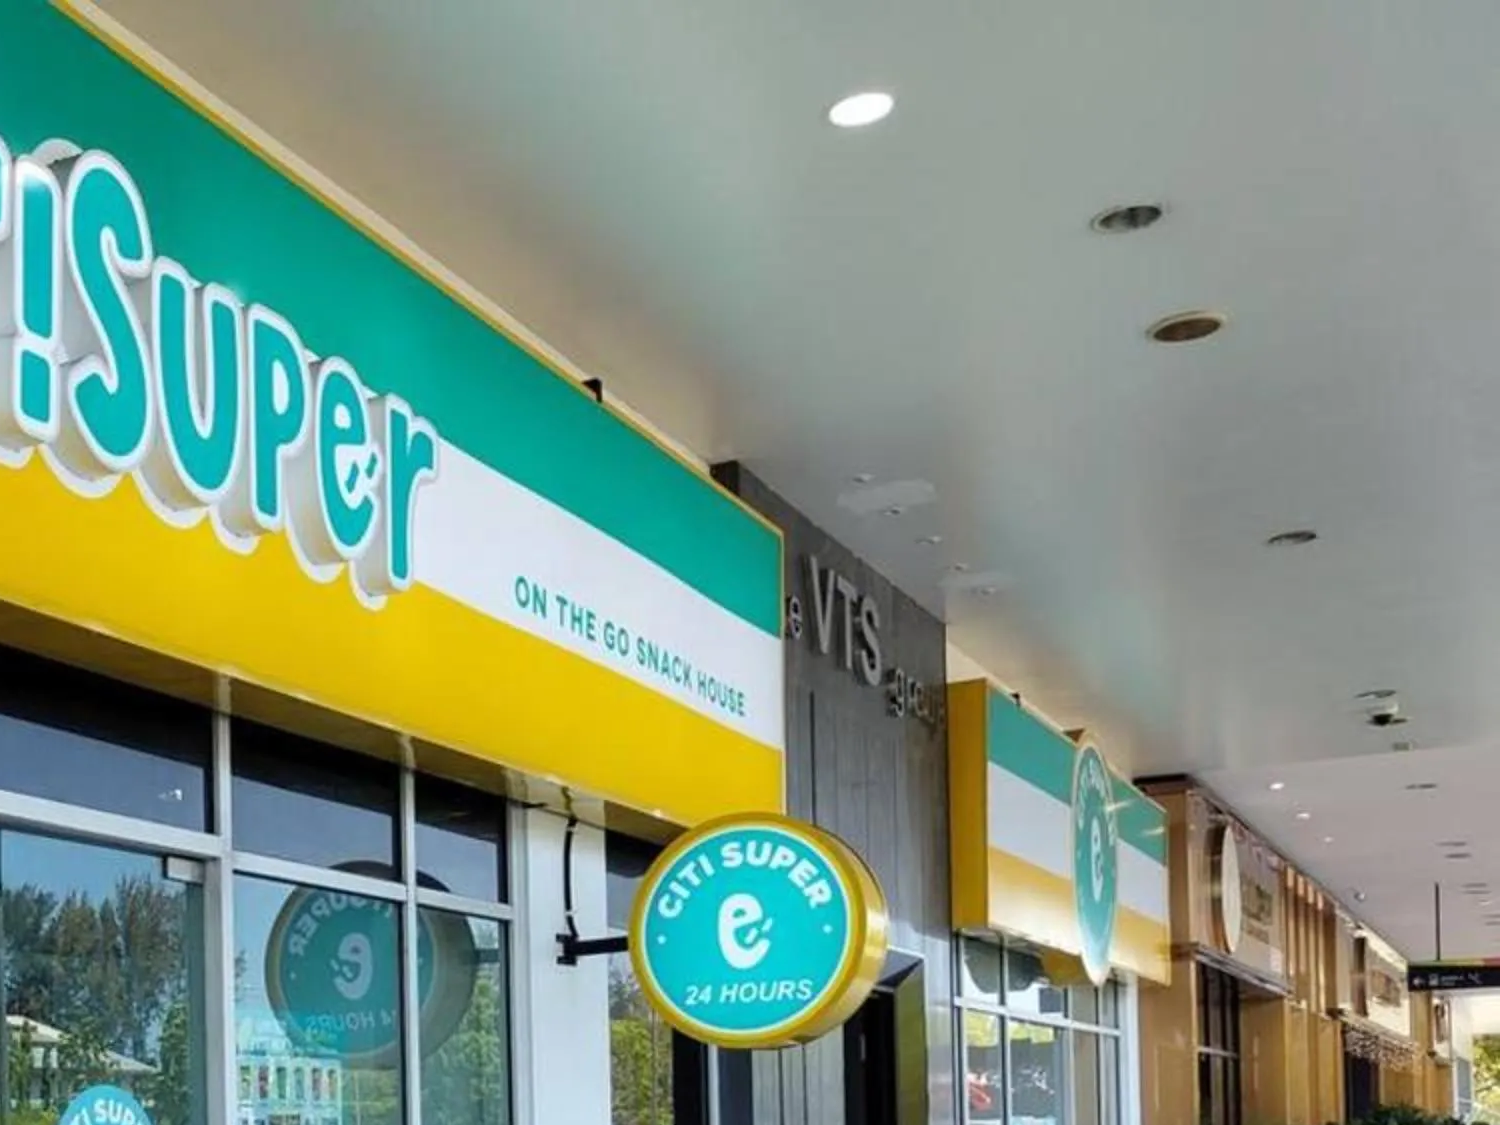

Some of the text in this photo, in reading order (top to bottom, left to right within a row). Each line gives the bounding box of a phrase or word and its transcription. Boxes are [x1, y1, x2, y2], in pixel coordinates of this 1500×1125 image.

[514, 575, 746, 717] ON THE GO SNACK HOUSE
[810, 555, 882, 686] VTS
[657, 840, 833, 918] CITI SUPER
[685, 979, 813, 1006] 24 HOURS
